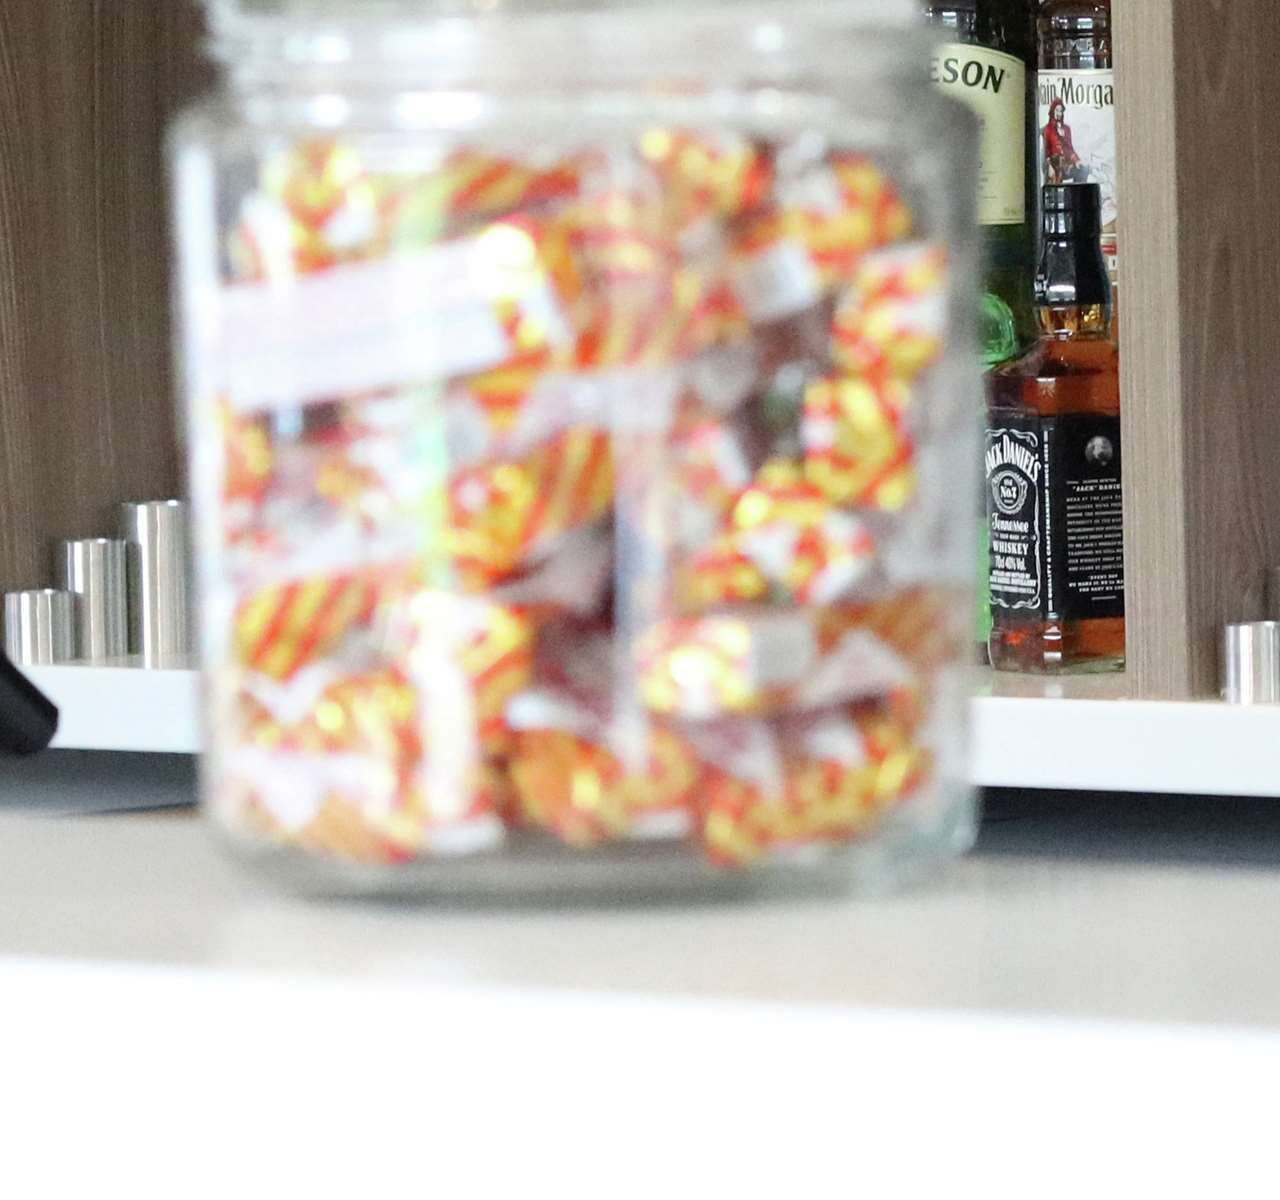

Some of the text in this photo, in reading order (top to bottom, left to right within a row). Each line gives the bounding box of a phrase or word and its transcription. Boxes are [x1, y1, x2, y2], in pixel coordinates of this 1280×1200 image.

[929, 57, 1005, 94] ESON
[1058, 77, 1114, 110] Morga
[1002, 434, 1042, 482] DANIEL'S
[992, 513, 1029, 533] Tennessee
[993, 541, 1029, 555] WHISKEY
